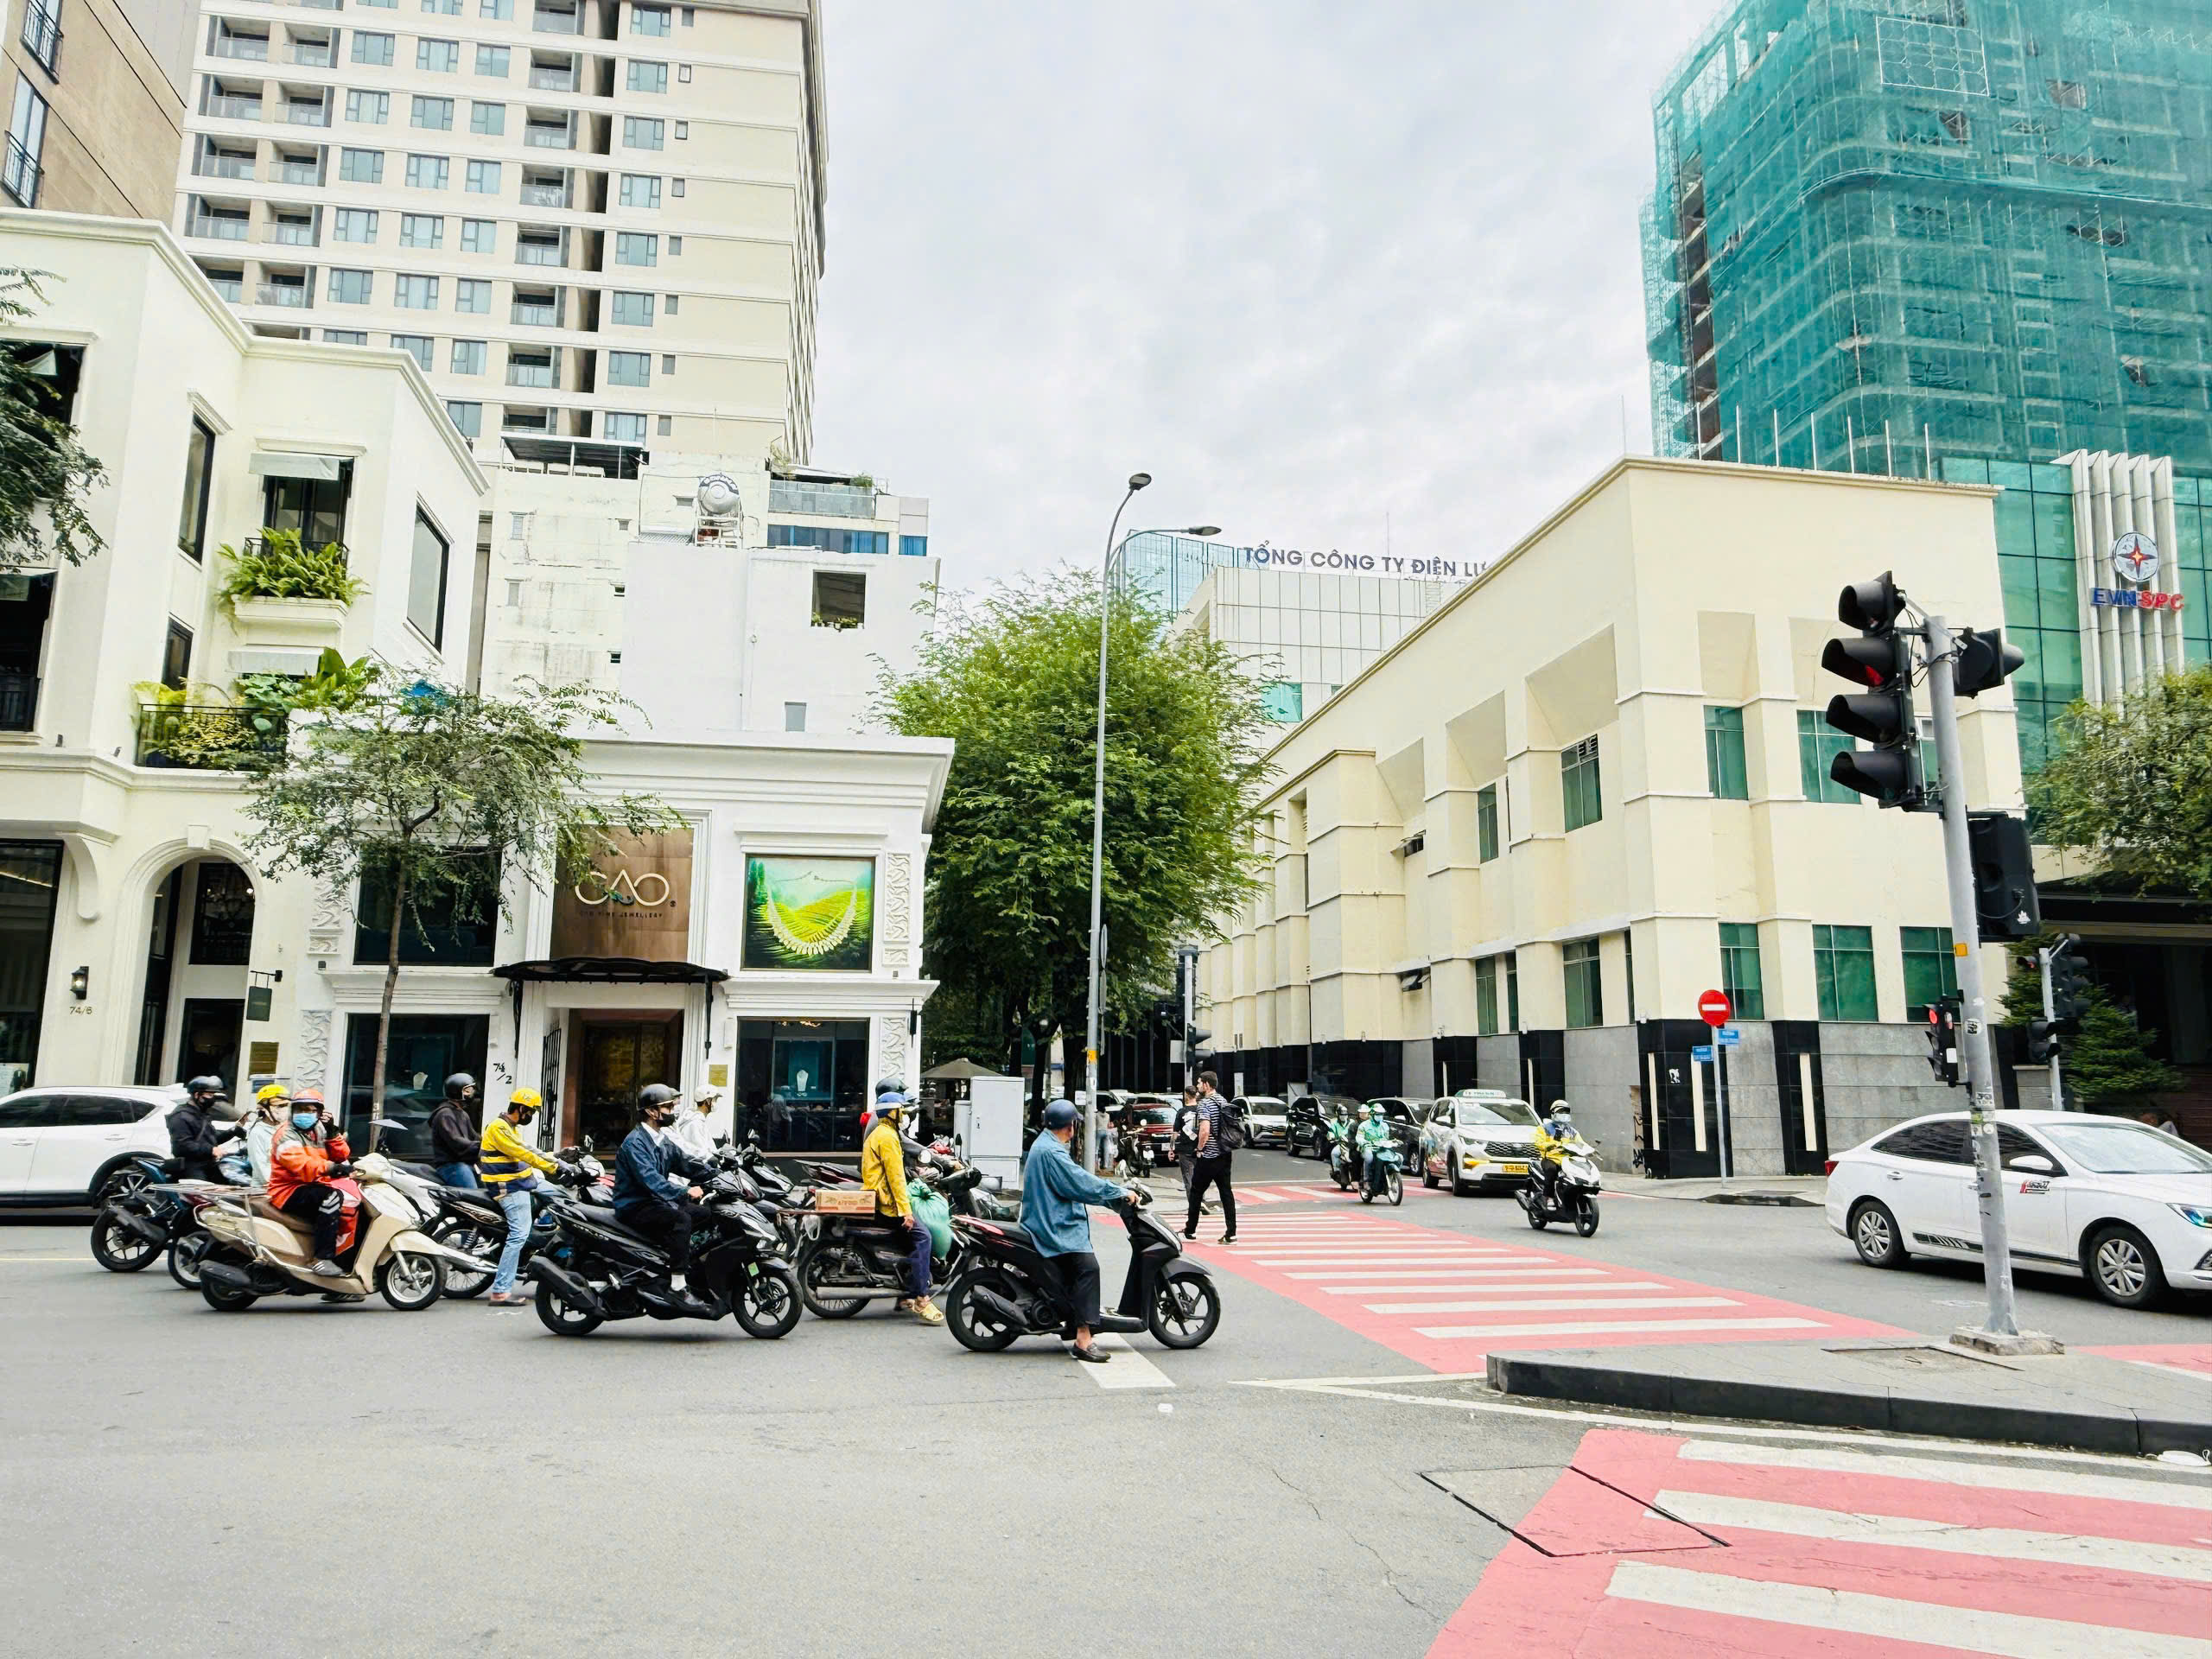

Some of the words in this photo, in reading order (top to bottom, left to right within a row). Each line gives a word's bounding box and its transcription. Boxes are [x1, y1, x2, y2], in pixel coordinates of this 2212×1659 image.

[1244, 540, 1303, 566] TỔNG
[1310, 549, 1375, 570] CÔNG
[1382, 556, 1404, 573] TY
